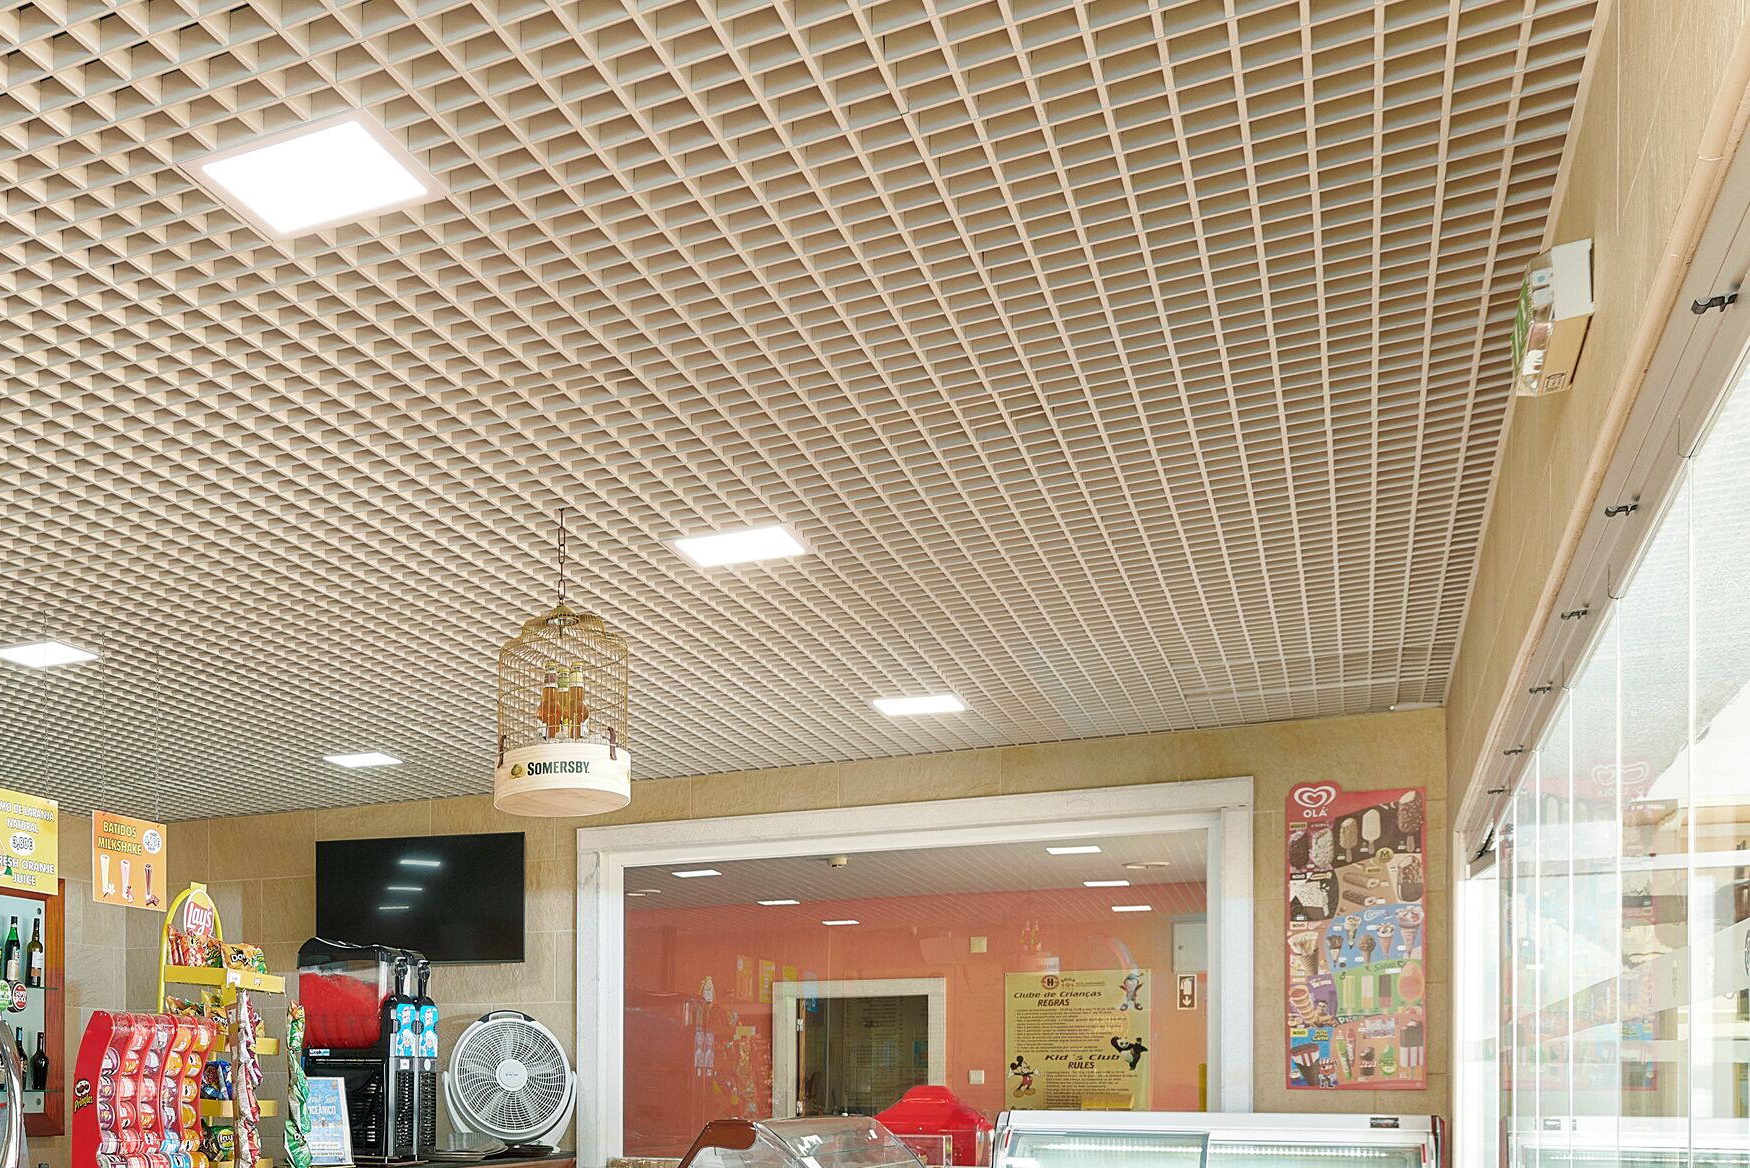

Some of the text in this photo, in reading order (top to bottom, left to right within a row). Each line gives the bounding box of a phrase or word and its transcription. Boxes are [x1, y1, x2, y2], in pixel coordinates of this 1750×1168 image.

[527, 761, 589, 776] SOMERSBY
[13, 804, 23, 814] DE
[24, 806, 54, 822] LARANJA
[1303, 806, 1328, 818] OLÁ
[7, 818, 39, 833] NATURAL
[103, 820, 137, 838] BATIDOS
[98, 836, 142, 856] MILKSHAKE
[21, 859, 54, 874] ORANJE
[13, 873, 36, 886] JUICE
[187, 903, 213, 936] Lay's
[1037, 999, 1070, 1007] REGRAS
[1068, 1061, 1095, 1069] RULES
[74, 1094, 93, 1113] Pringles
